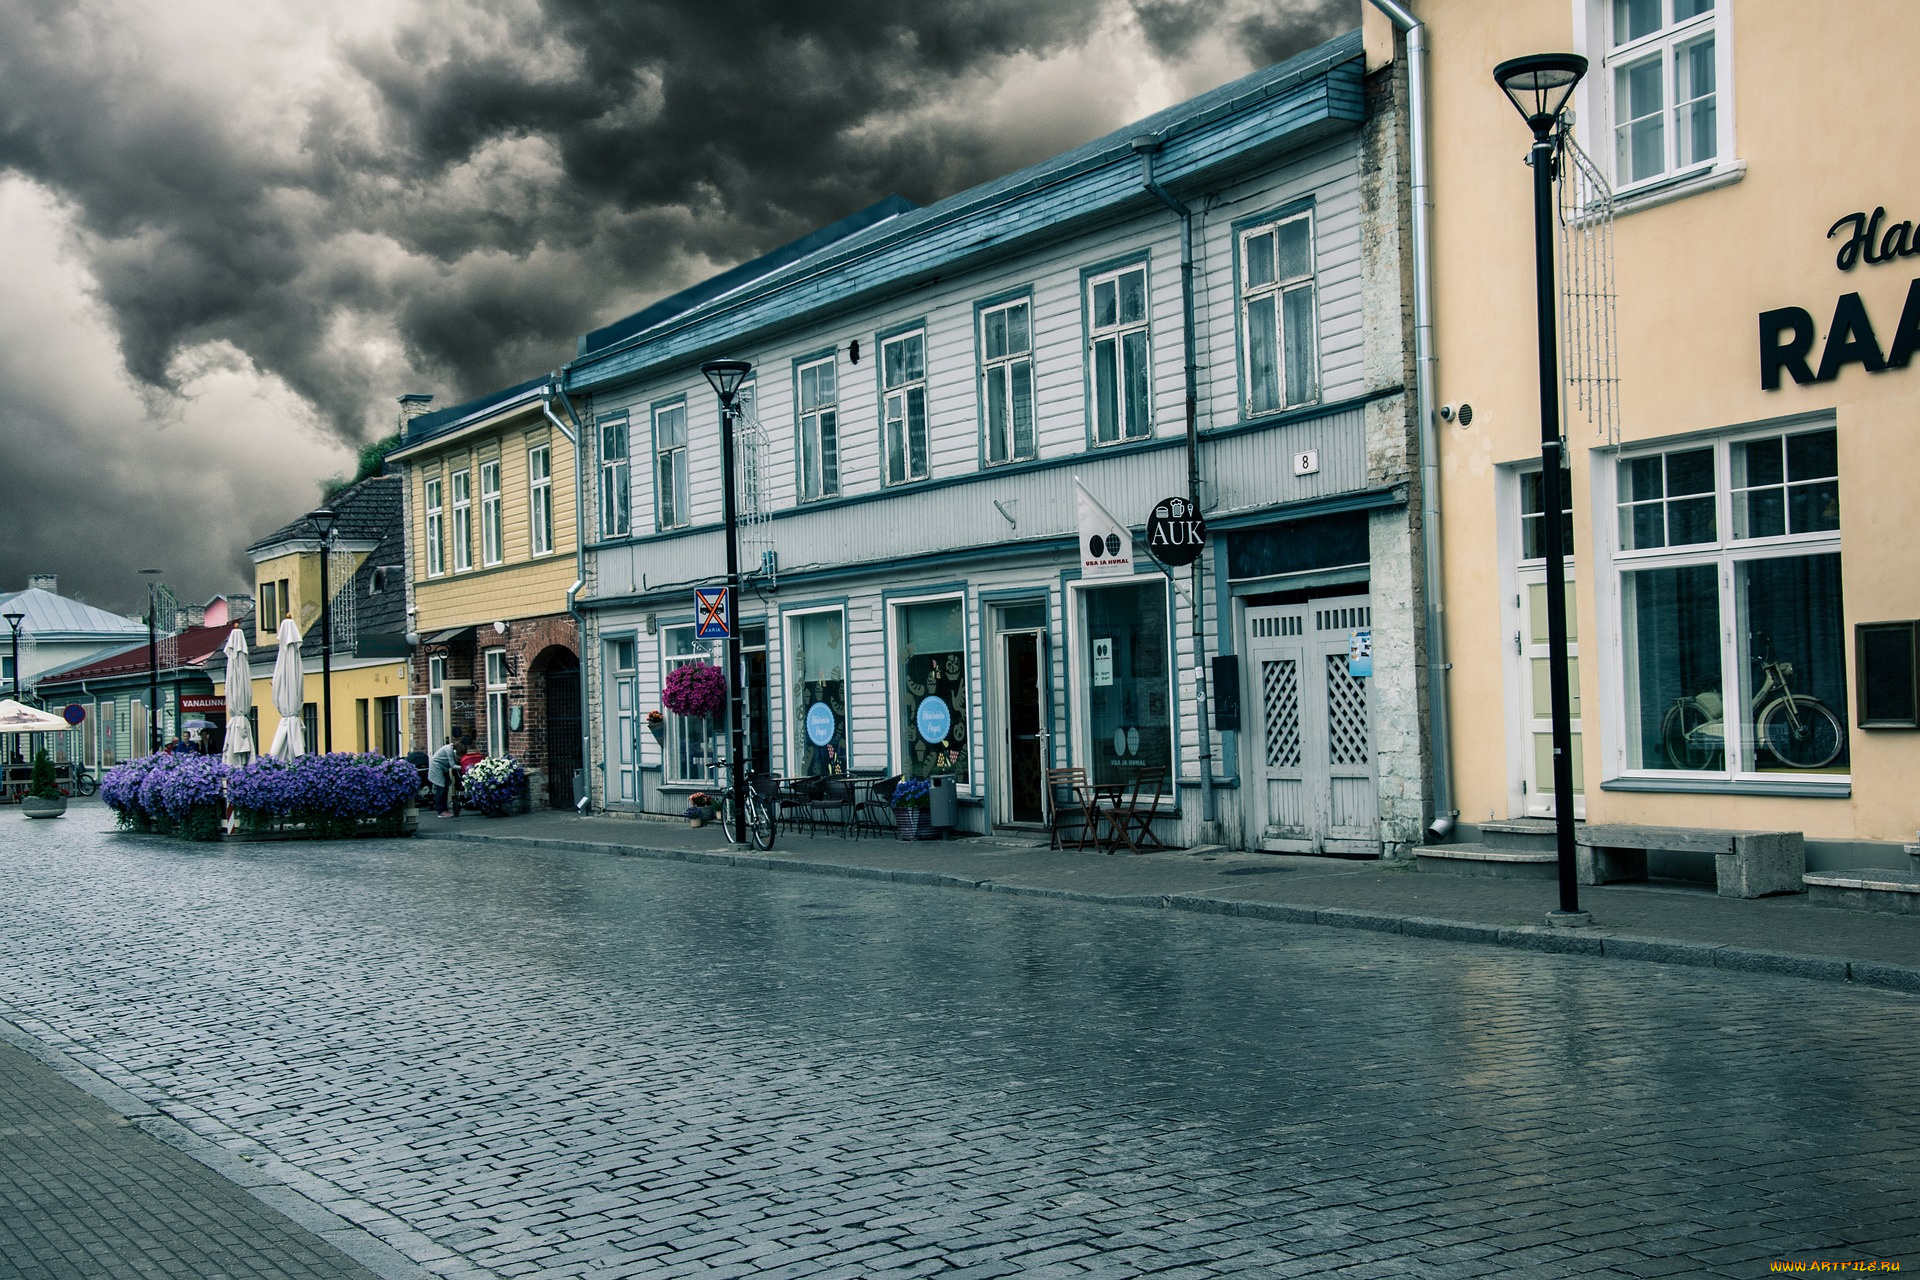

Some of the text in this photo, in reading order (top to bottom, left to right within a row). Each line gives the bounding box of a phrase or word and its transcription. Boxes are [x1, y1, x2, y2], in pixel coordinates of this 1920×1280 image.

[1826, 206, 1920, 271] Ha
[1302, 455, 1309, 469] 8
[1151, 520, 1204, 545] AUK
